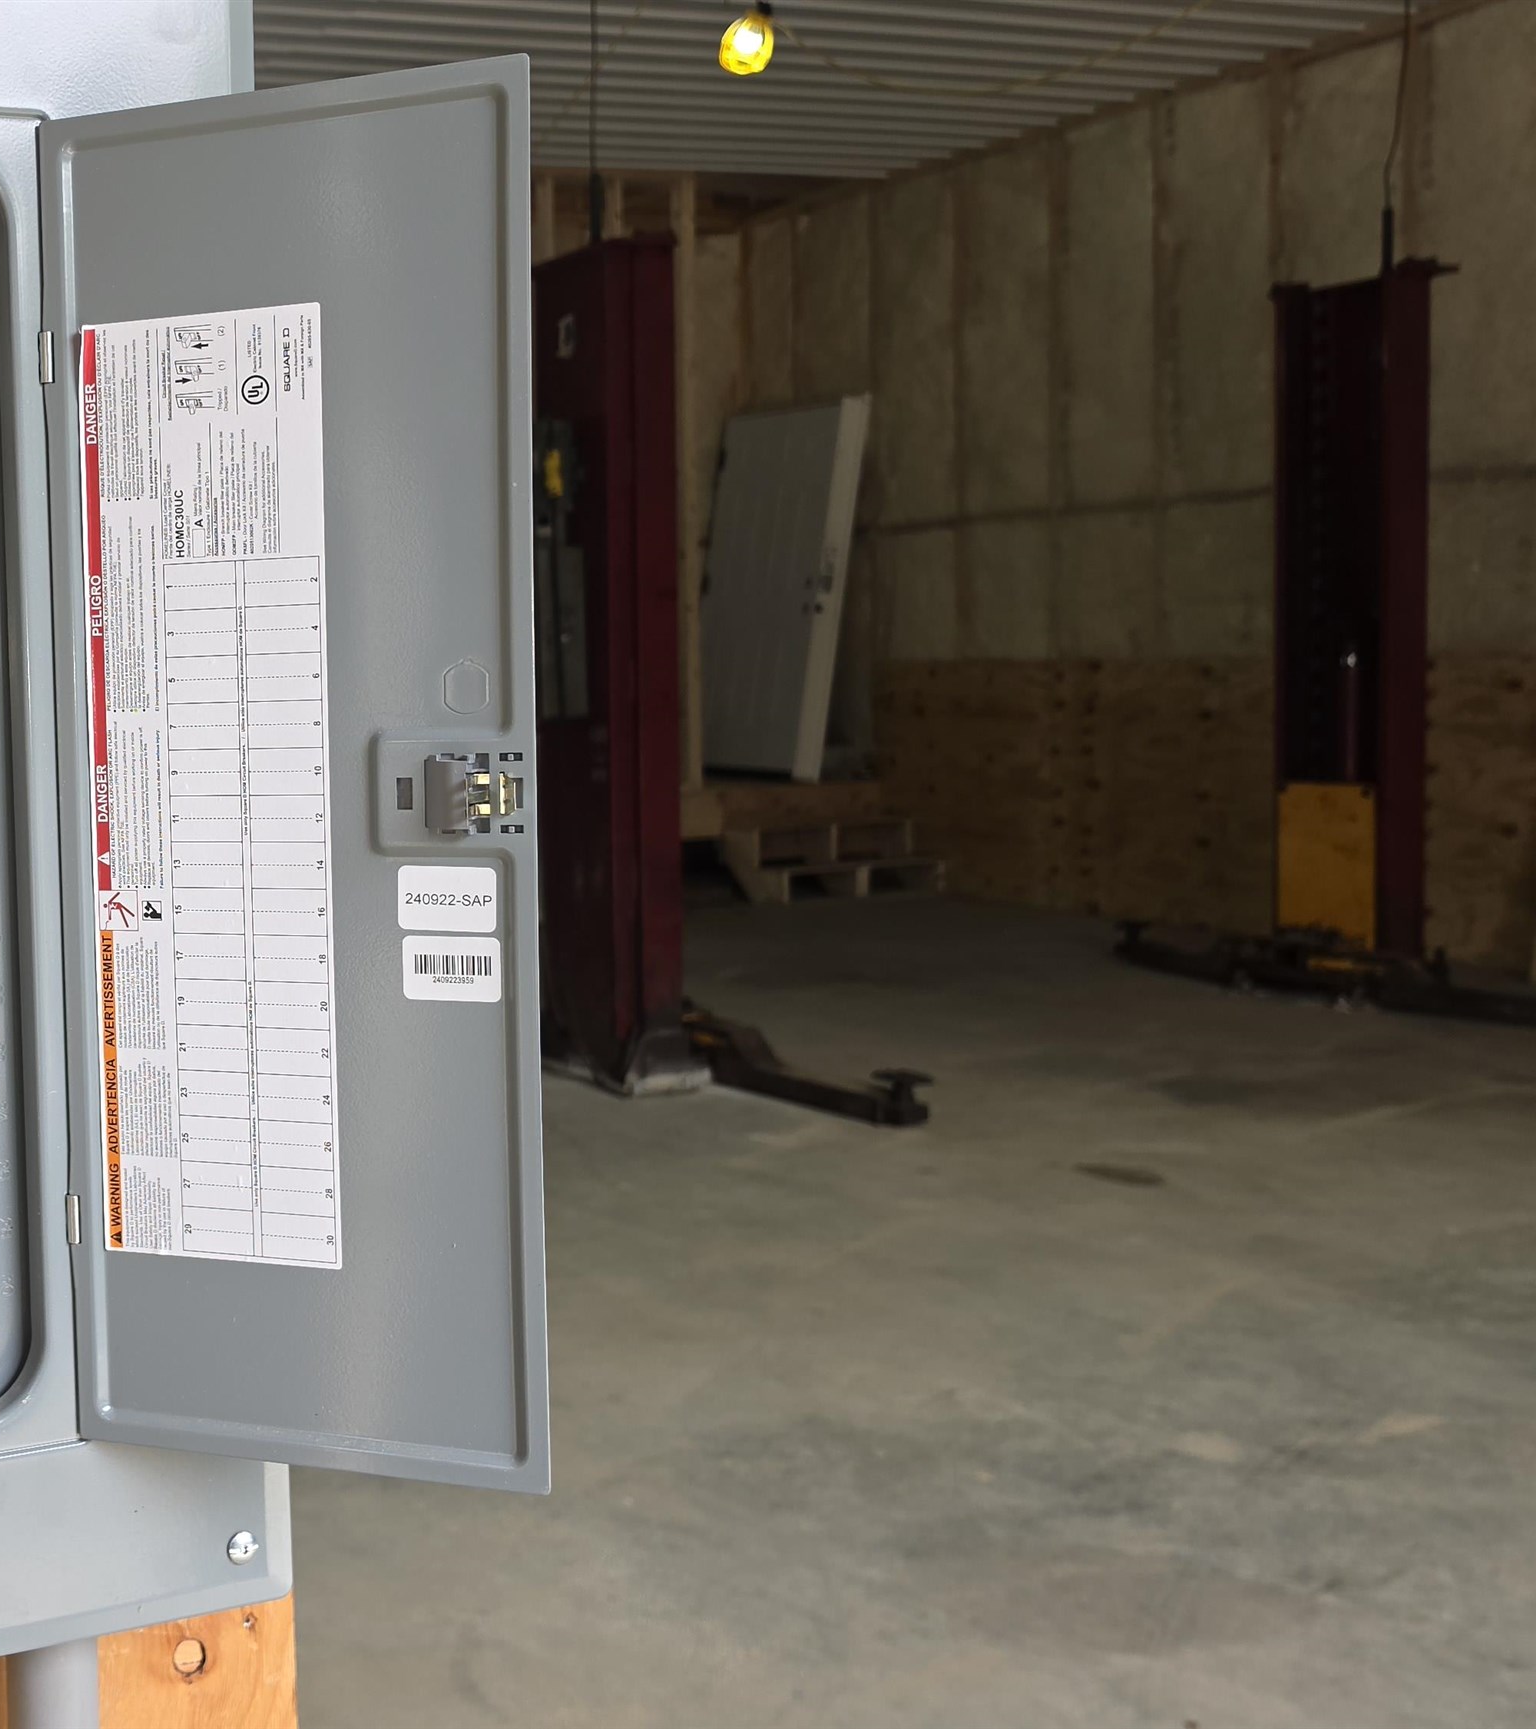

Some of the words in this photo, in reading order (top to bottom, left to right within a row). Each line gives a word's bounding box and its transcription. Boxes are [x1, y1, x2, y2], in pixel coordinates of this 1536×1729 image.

[283, 328, 290, 338] D
[85, 384, 97, 445] DANGER
[174, 490, 184, 558] HOMC30UC
[194, 519, 203, 527] A
[91, 575, 102, 636] PELIGRO
[314, 766, 321, 776] 10
[97, 765, 108, 822] DANGER
[172, 815, 179, 823] 11
[316, 813, 322, 823] 12
[174, 860, 180, 869] 13
[317, 860, 324, 870] 14
[405, 892, 492, 907] 240922-SAP
[175, 905, 182, 914] 15
[318, 907, 325, 917] 16
[176, 951, 183, 960] 17
[319, 954, 326, 964] 18
[432, 976, 474, 984] 2409223959
[102, 935, 115, 1046] AVERTISSEMENT
[177, 997, 184, 1006] 19
[320, 1001, 327, 1011] 20
[179, 1043, 186, 1052] 21
[321, 1048, 328, 1058] 22
[180, 1088, 187, 1097] 23
[323, 1095, 330, 1105] 24
[105, 1059, 118, 1154] ADVERTENCIA
[182, 1133, 189, 1143] 25
[324, 1142, 331, 1152] 26
[183, 1178, 190, 1188] 27
[110, 1163, 120, 1226] WARNING
[325, 1189, 332, 1199] 28
[185, 1224, 192, 1234] 29
[327, 1235, 334, 1245] 30
